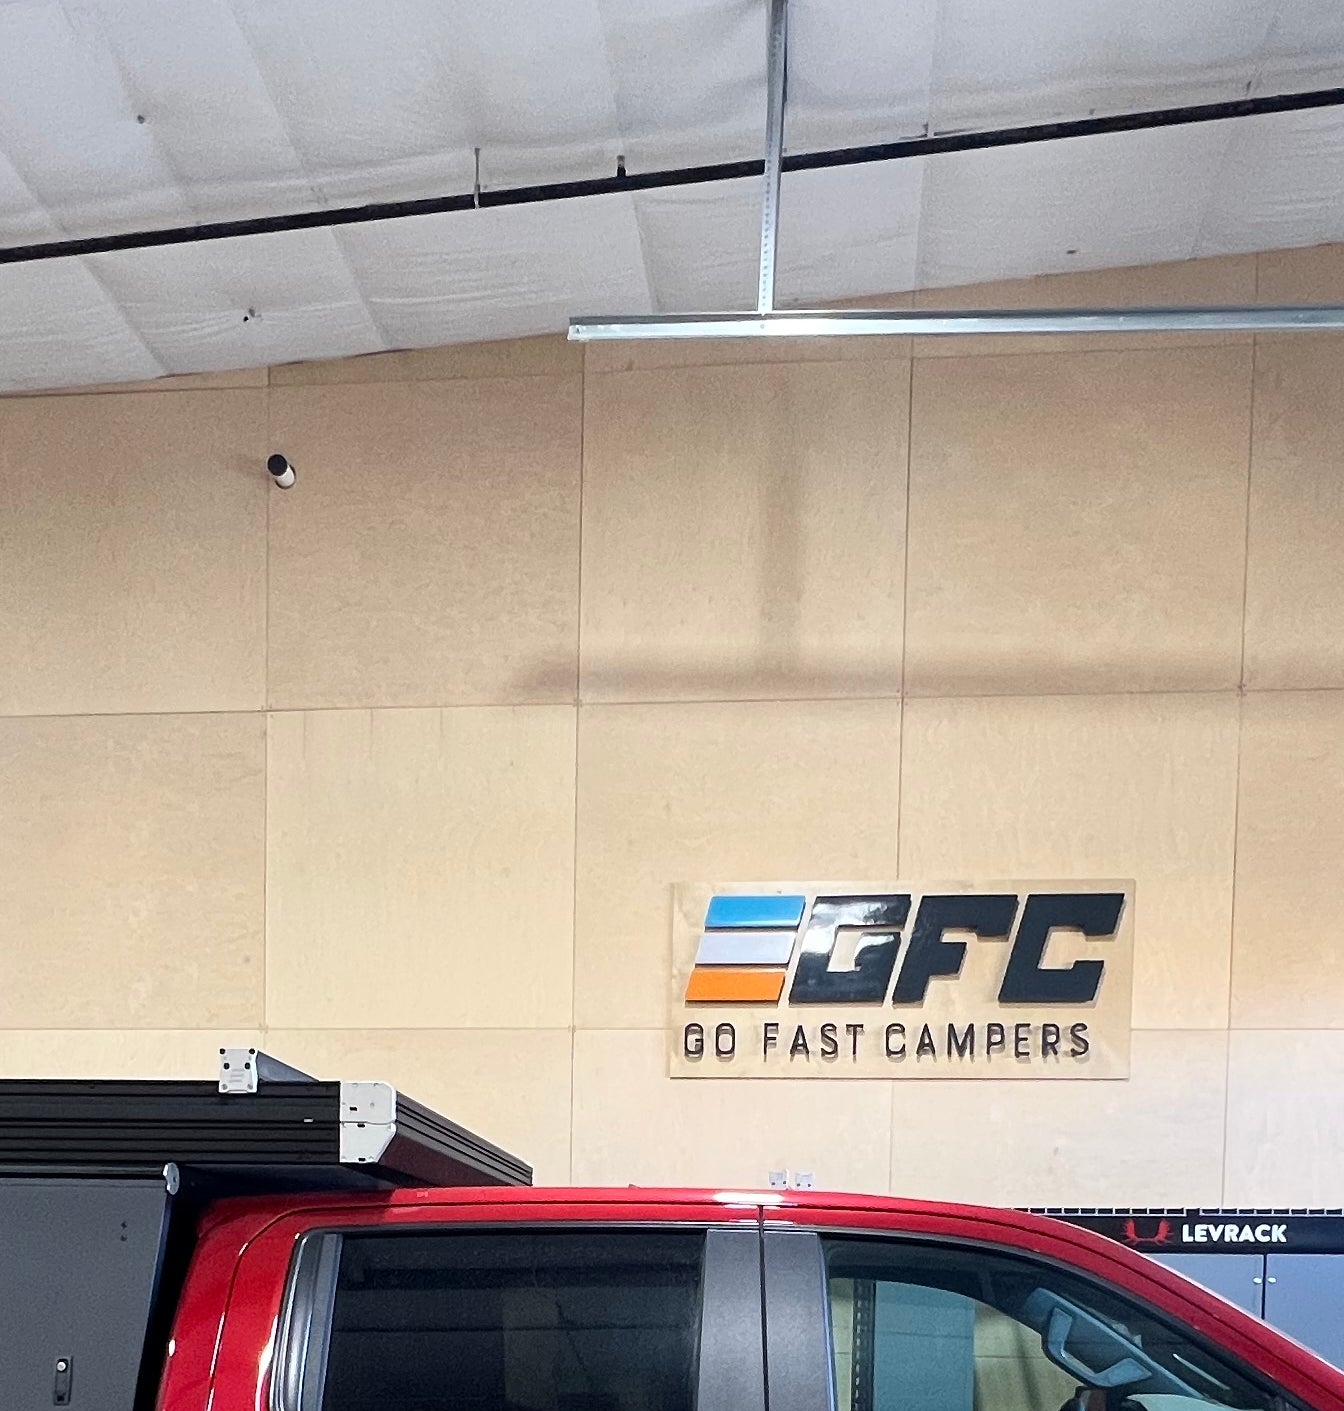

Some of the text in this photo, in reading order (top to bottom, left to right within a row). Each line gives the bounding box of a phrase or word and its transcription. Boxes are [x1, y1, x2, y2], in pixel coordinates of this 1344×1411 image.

[788, 892, 1125, 1003] GFC
[683, 1022, 1091, 1058] GO FAST CAMPERS
[1181, 1223, 1288, 1243] LEVRACK
